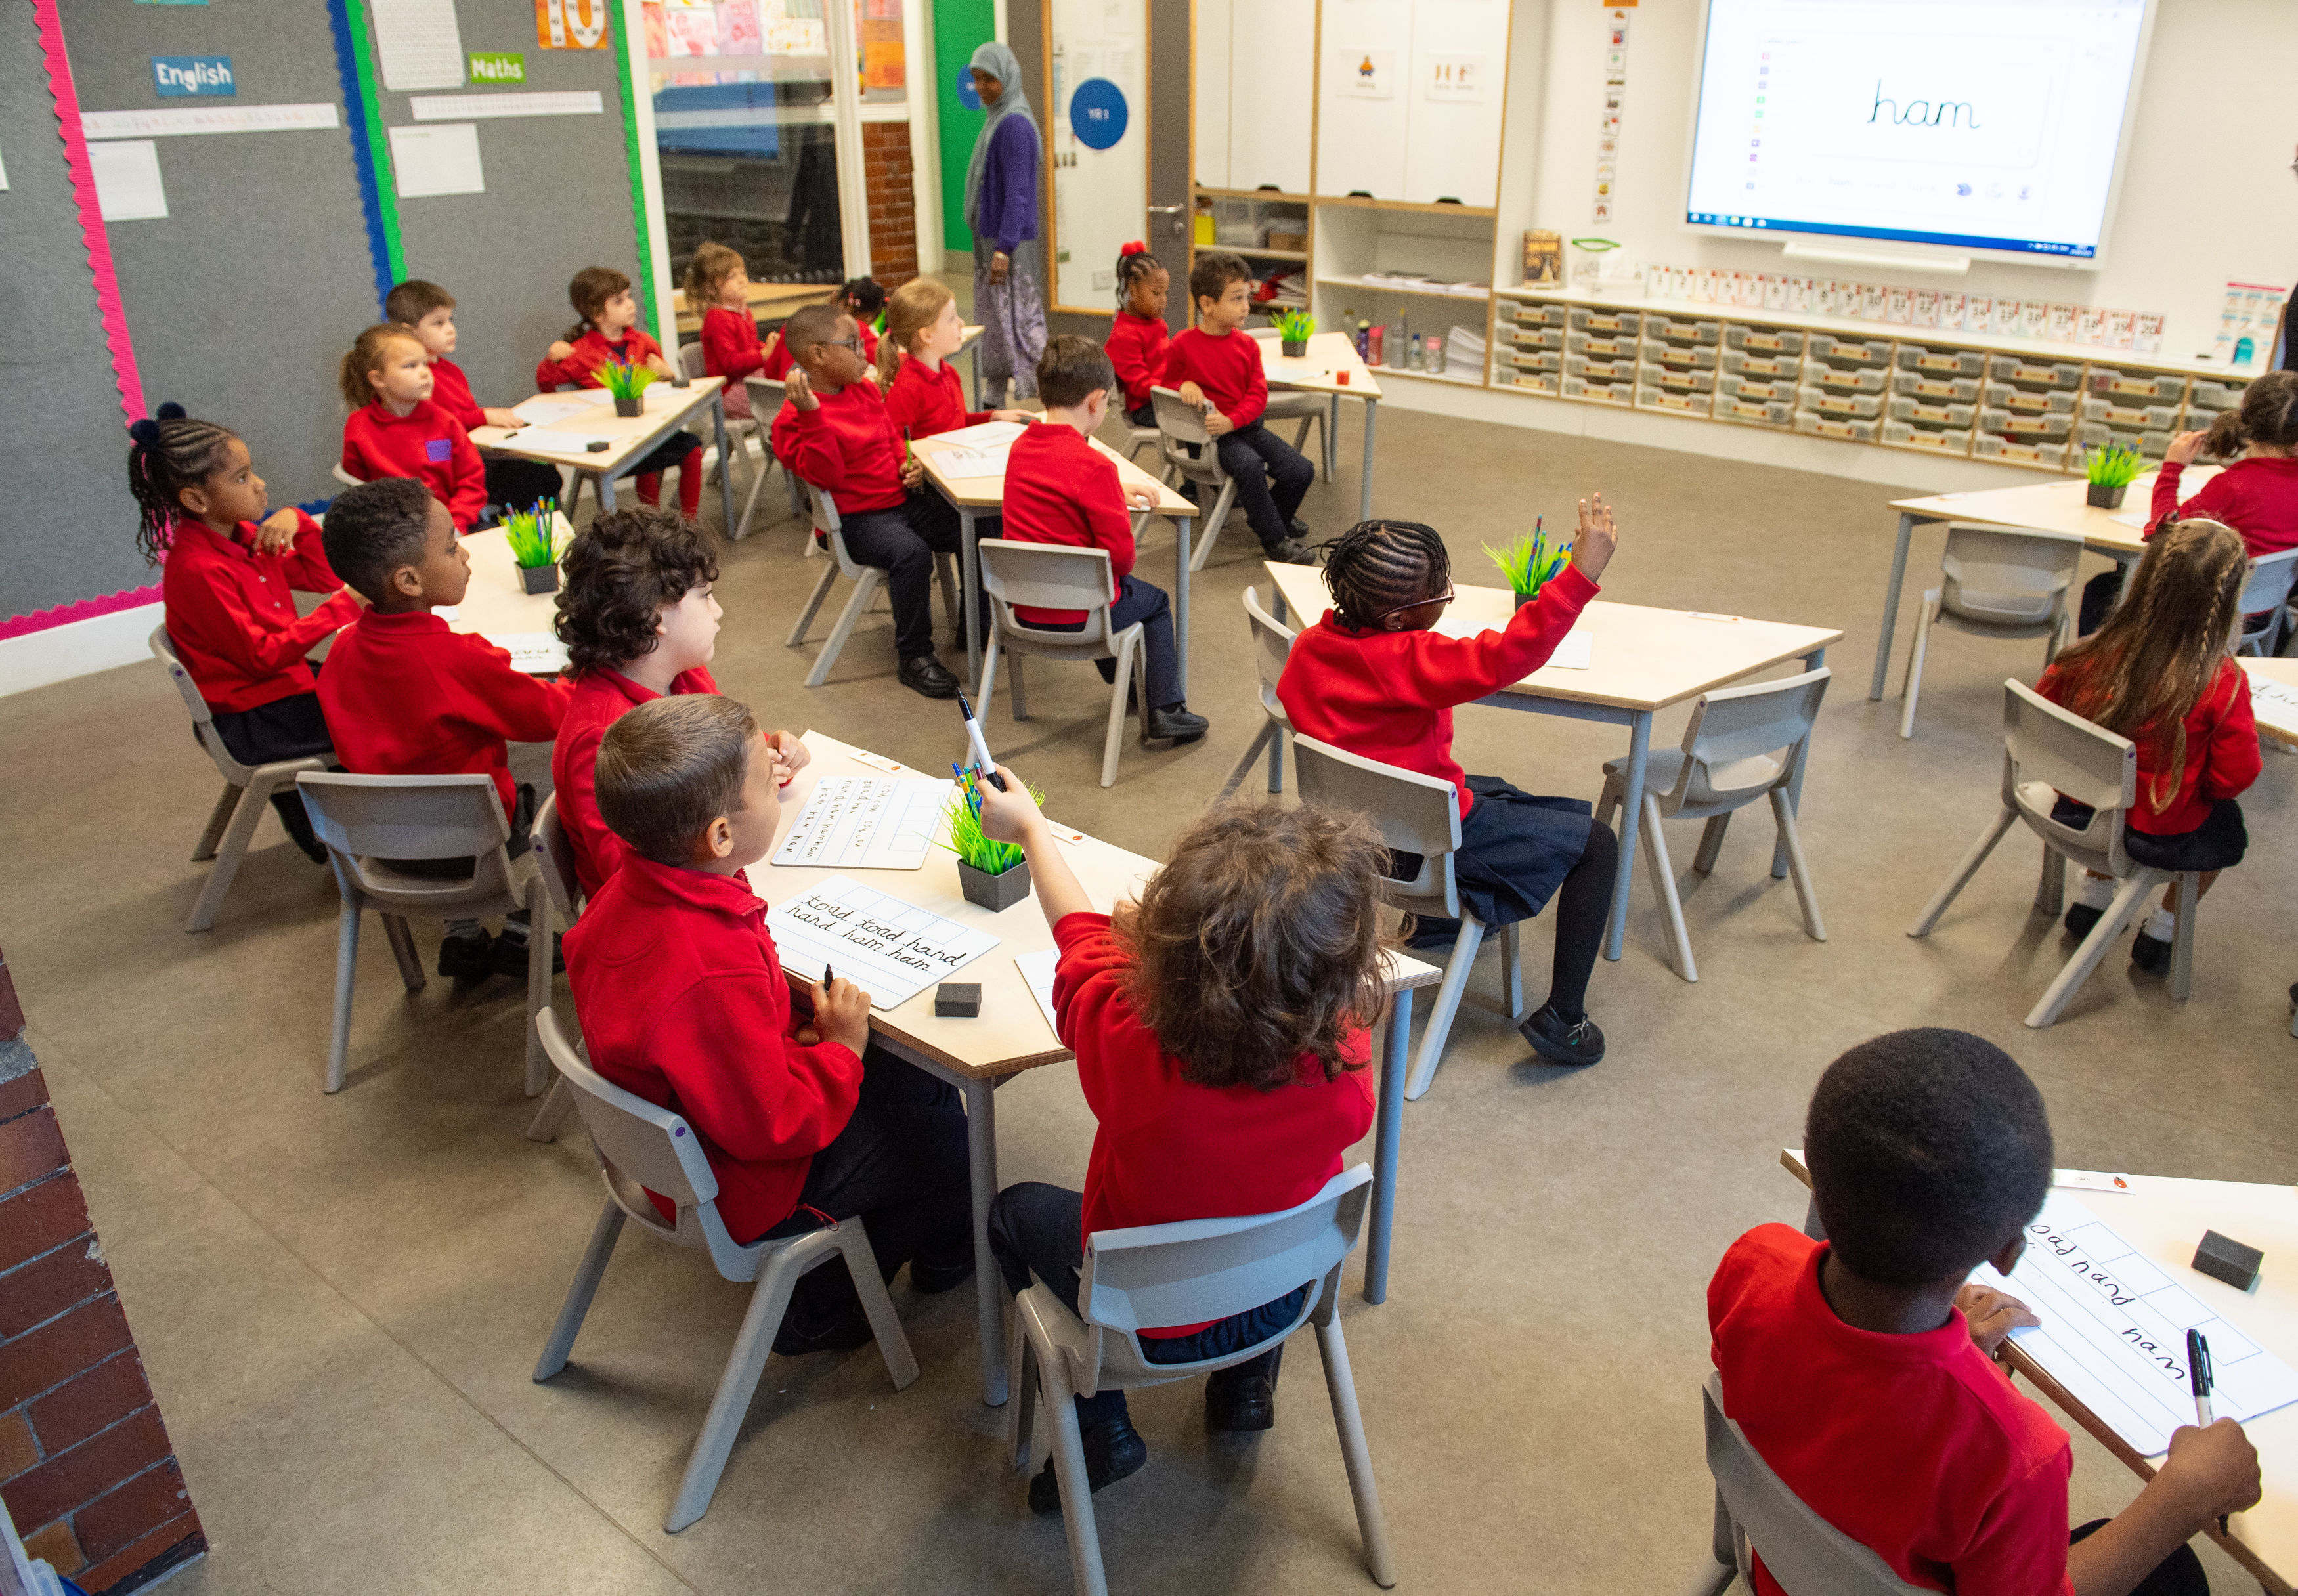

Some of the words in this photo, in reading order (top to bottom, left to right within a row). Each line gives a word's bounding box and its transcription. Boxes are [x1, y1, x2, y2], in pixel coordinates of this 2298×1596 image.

[472, 58, 523, 78] Maths
[156, 62, 232, 92] English
[1867, 79, 1980, 129] ham
[1087, 108, 1103, 120] YR
[1820, 288, 1829, 301] 8
[1846, 291, 1854, 301] 9
[1868, 293, 1882, 305] 10
[1893, 299, 1906, 309] 11
[1919, 300, 1933, 310] 12
[1945, 303, 1960, 314] 13
[1972, 307, 1986, 317] 14
[2000, 310, 2014, 322] 15
[2027, 312, 2041, 322] 16
[2056, 314, 2071, 325] 17
[2083, 318, 2098, 329] 18
[2114, 320, 2128, 332] 19
[2141, 324, 2156, 335] 20
[801, 895, 855, 922] toad
[856, 918, 906, 942] toad
[903, 937, 966, 966] hand
[786, 904, 837, 932] hand
[840, 928, 884, 952] ham
[886, 948, 931, 972] ham
[2030, 1225, 2077, 1255] oad
[2071, 1261, 2136, 1305] hand
[2122, 1328, 2185, 1380] ham
